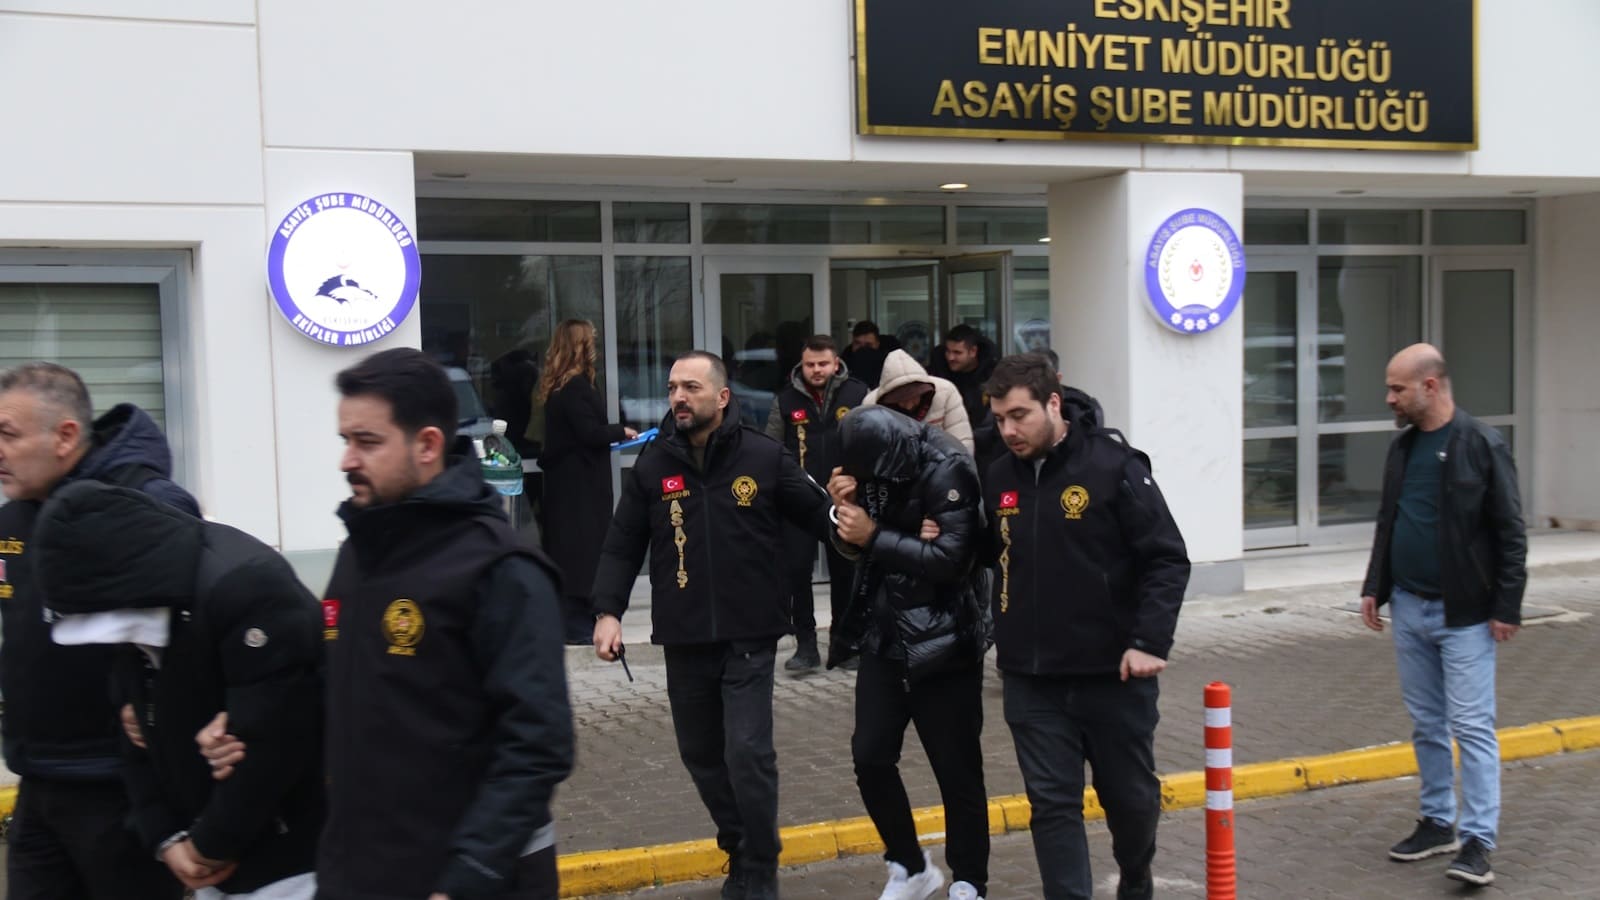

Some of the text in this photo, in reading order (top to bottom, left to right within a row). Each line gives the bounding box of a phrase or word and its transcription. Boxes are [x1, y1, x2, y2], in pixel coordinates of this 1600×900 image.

[978, 23, 1391, 83] EMNİYET MÜDÜRLÜĞÜ
[931, 74, 1429, 132] ASAYİŞ ŞUBE MÜDÜRLÜĞÜ
[293, 313, 339, 345] EKİPLER
[669, 499, 689, 588] ASAYİŞ
[999, 516, 1012, 613] ASAYİŞ
